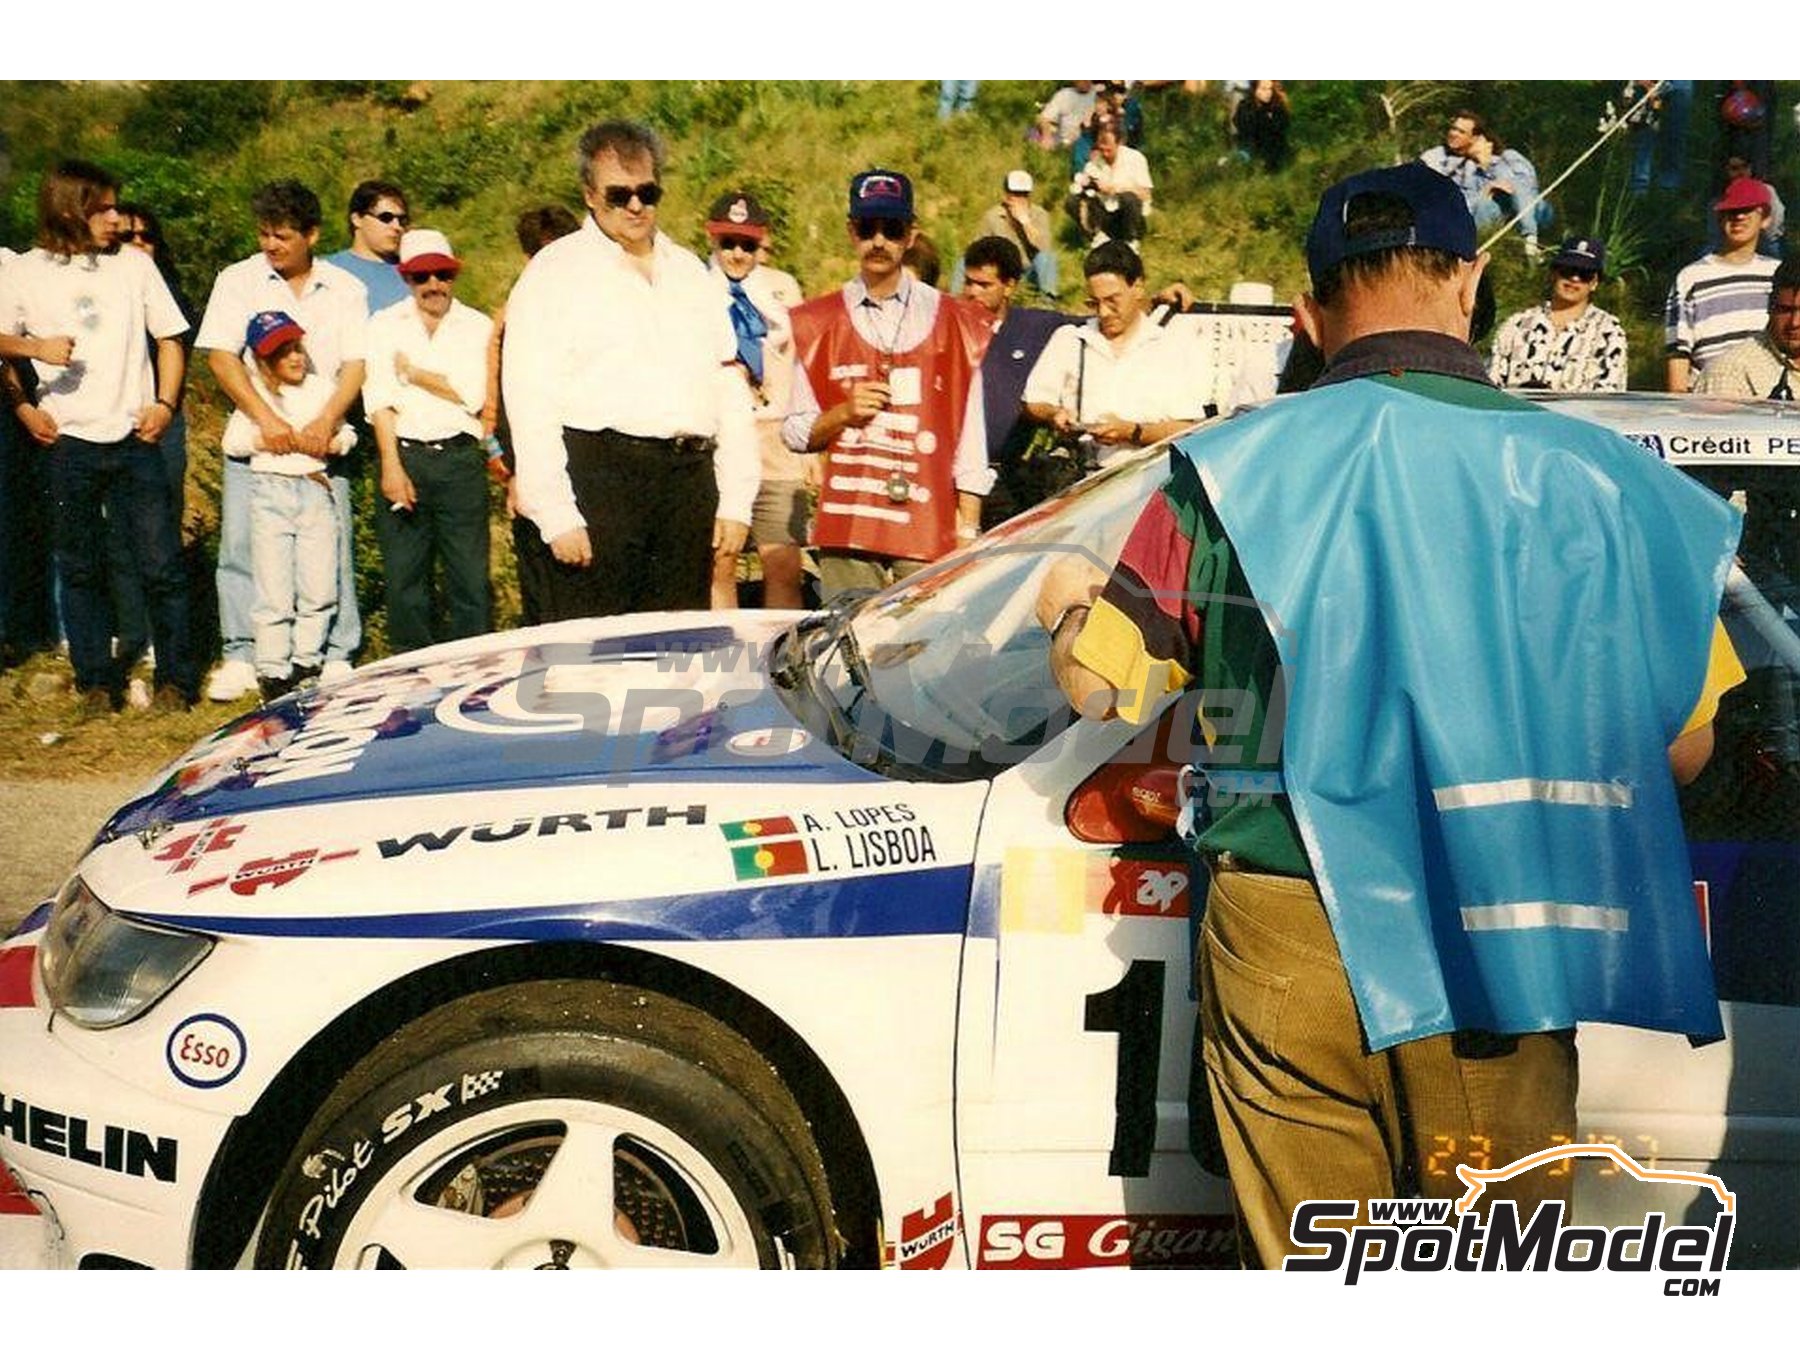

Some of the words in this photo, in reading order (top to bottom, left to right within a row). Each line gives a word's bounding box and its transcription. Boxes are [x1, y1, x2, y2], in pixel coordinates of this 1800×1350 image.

[1670, 436, 1751, 454] Crédit
[802, 813, 831, 833] A.
[834, 803, 916, 829] LOPES
[811, 838, 838, 872] L.
[845, 826, 937, 869] LISBOA
[381, 1082, 455, 1145] SX
[984, 1220, 1066, 1262] SG
